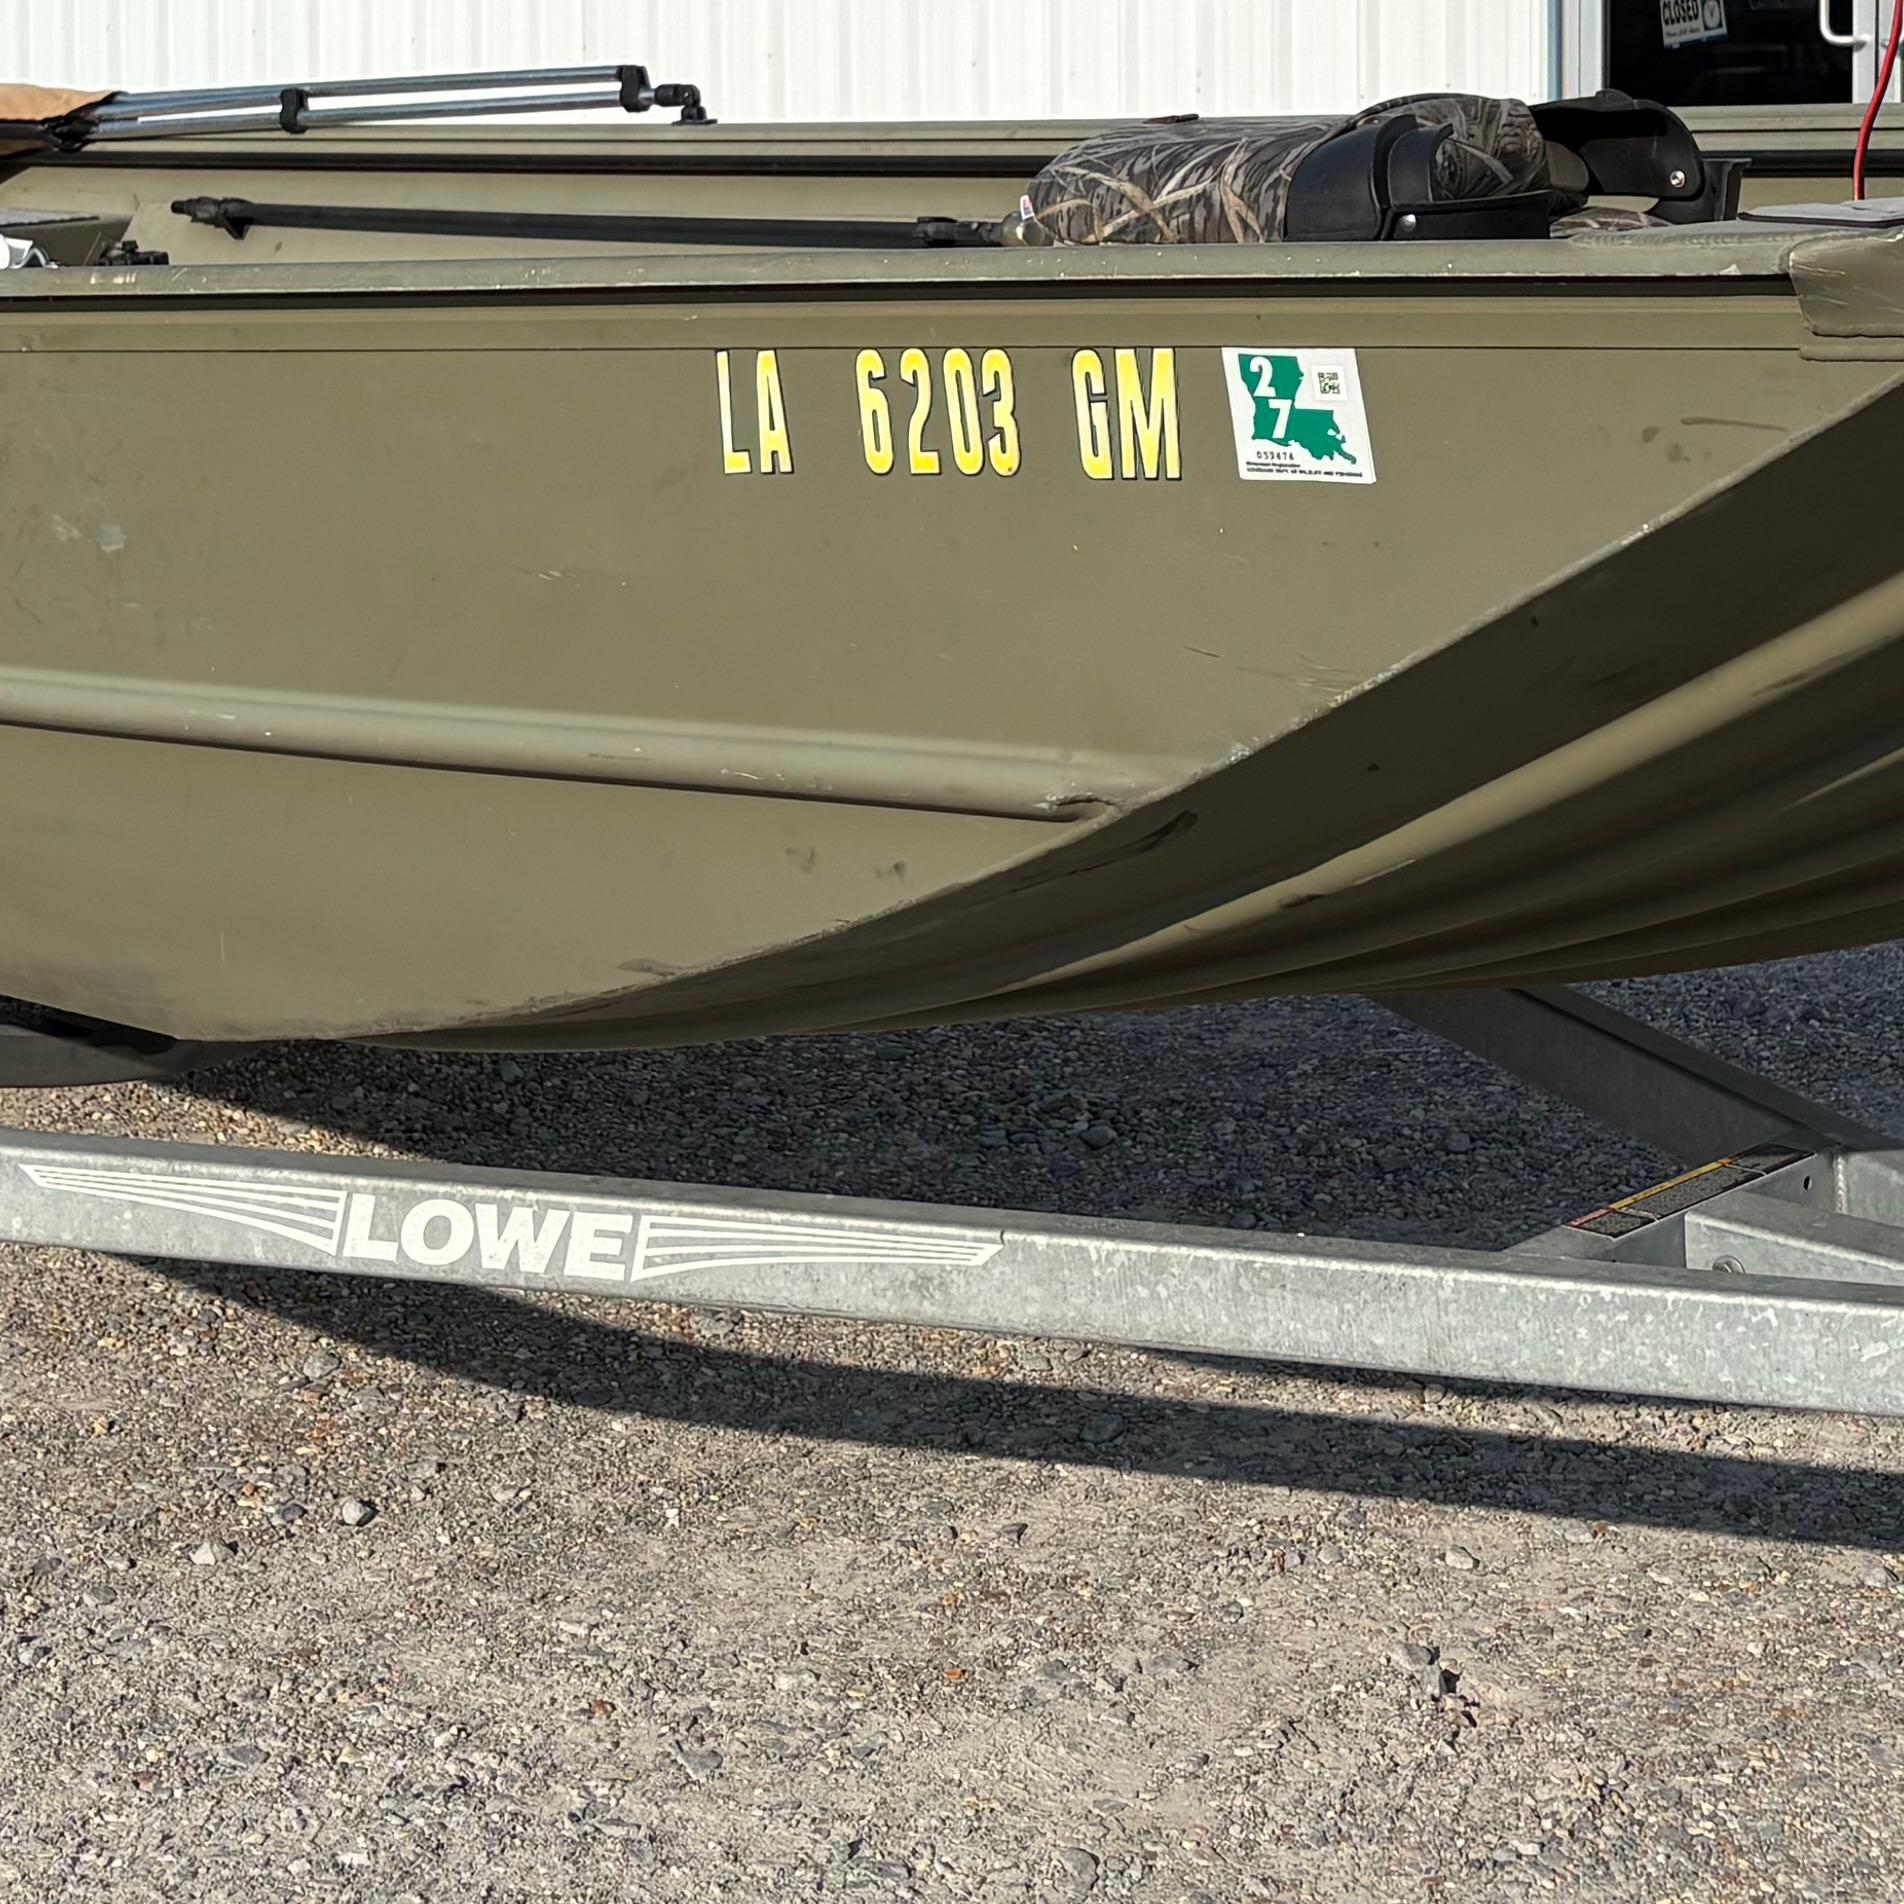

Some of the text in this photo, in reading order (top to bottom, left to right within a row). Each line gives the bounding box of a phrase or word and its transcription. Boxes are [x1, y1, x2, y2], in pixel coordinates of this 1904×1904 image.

[714, 346, 1184, 483] LA 6203 GM
[341, 1191, 635, 1283] LOWE
